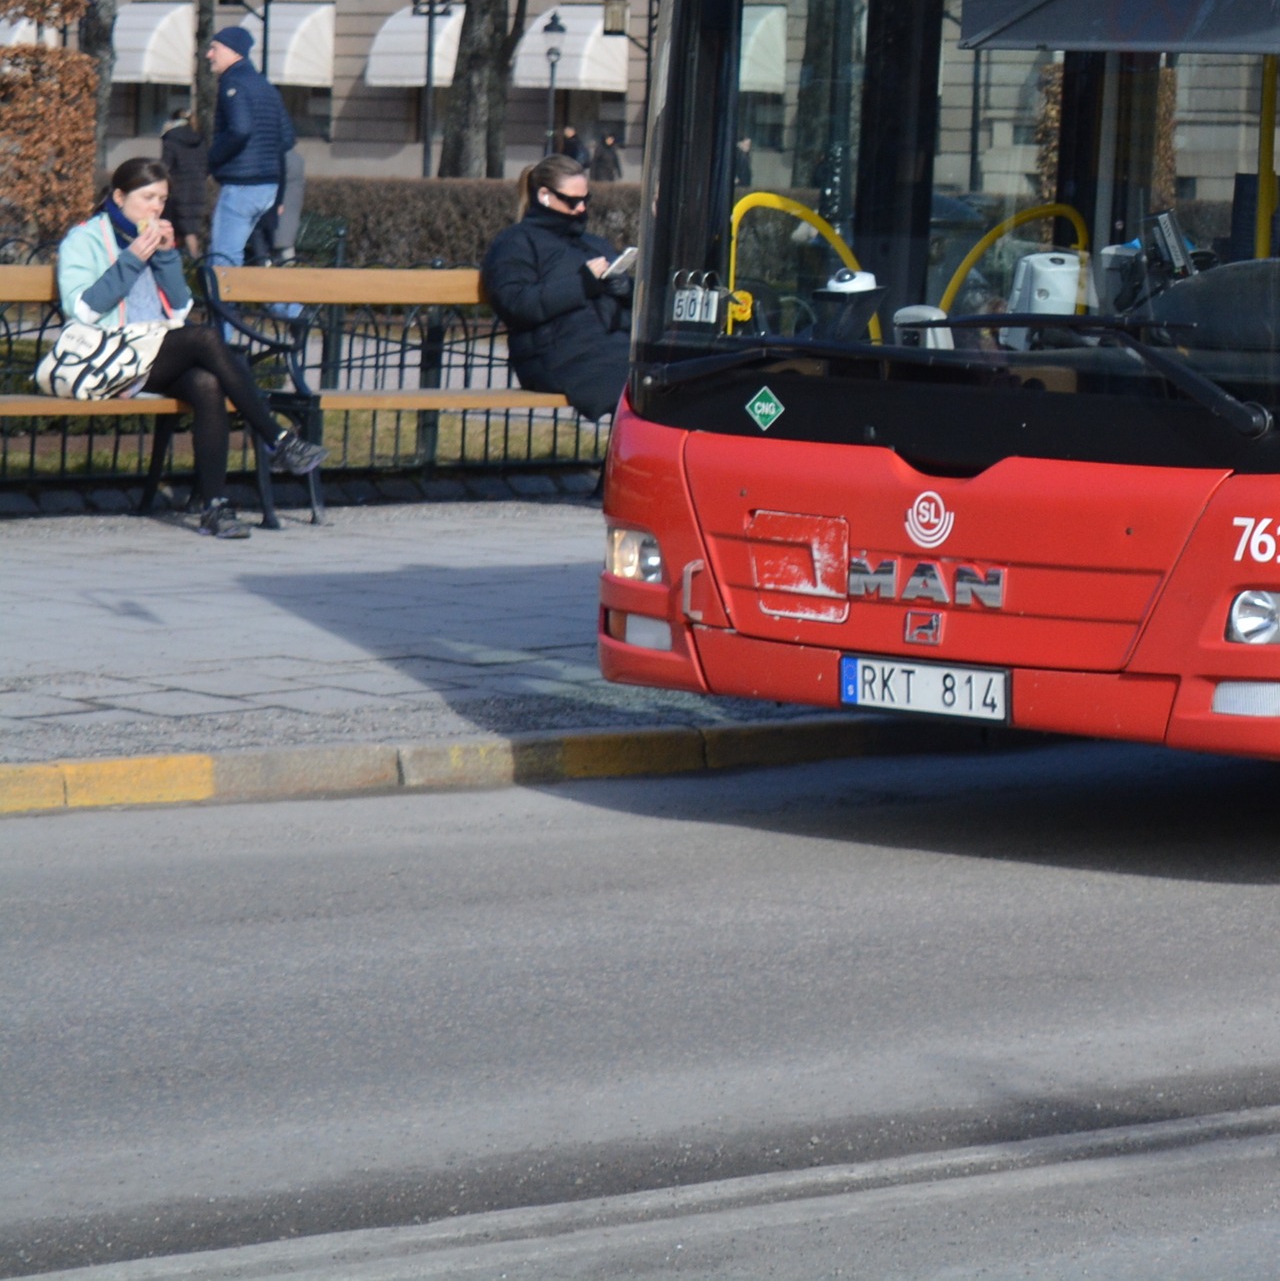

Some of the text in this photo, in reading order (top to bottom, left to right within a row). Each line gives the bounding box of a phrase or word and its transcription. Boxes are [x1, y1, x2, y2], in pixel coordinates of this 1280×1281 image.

[754, 402, 777, 416] CNG
[918, 500, 939, 525] SL
[850, 556, 1006, 609] MAN
[861, 664, 916, 704] RKT
[941, 672, 998, 714] 814
